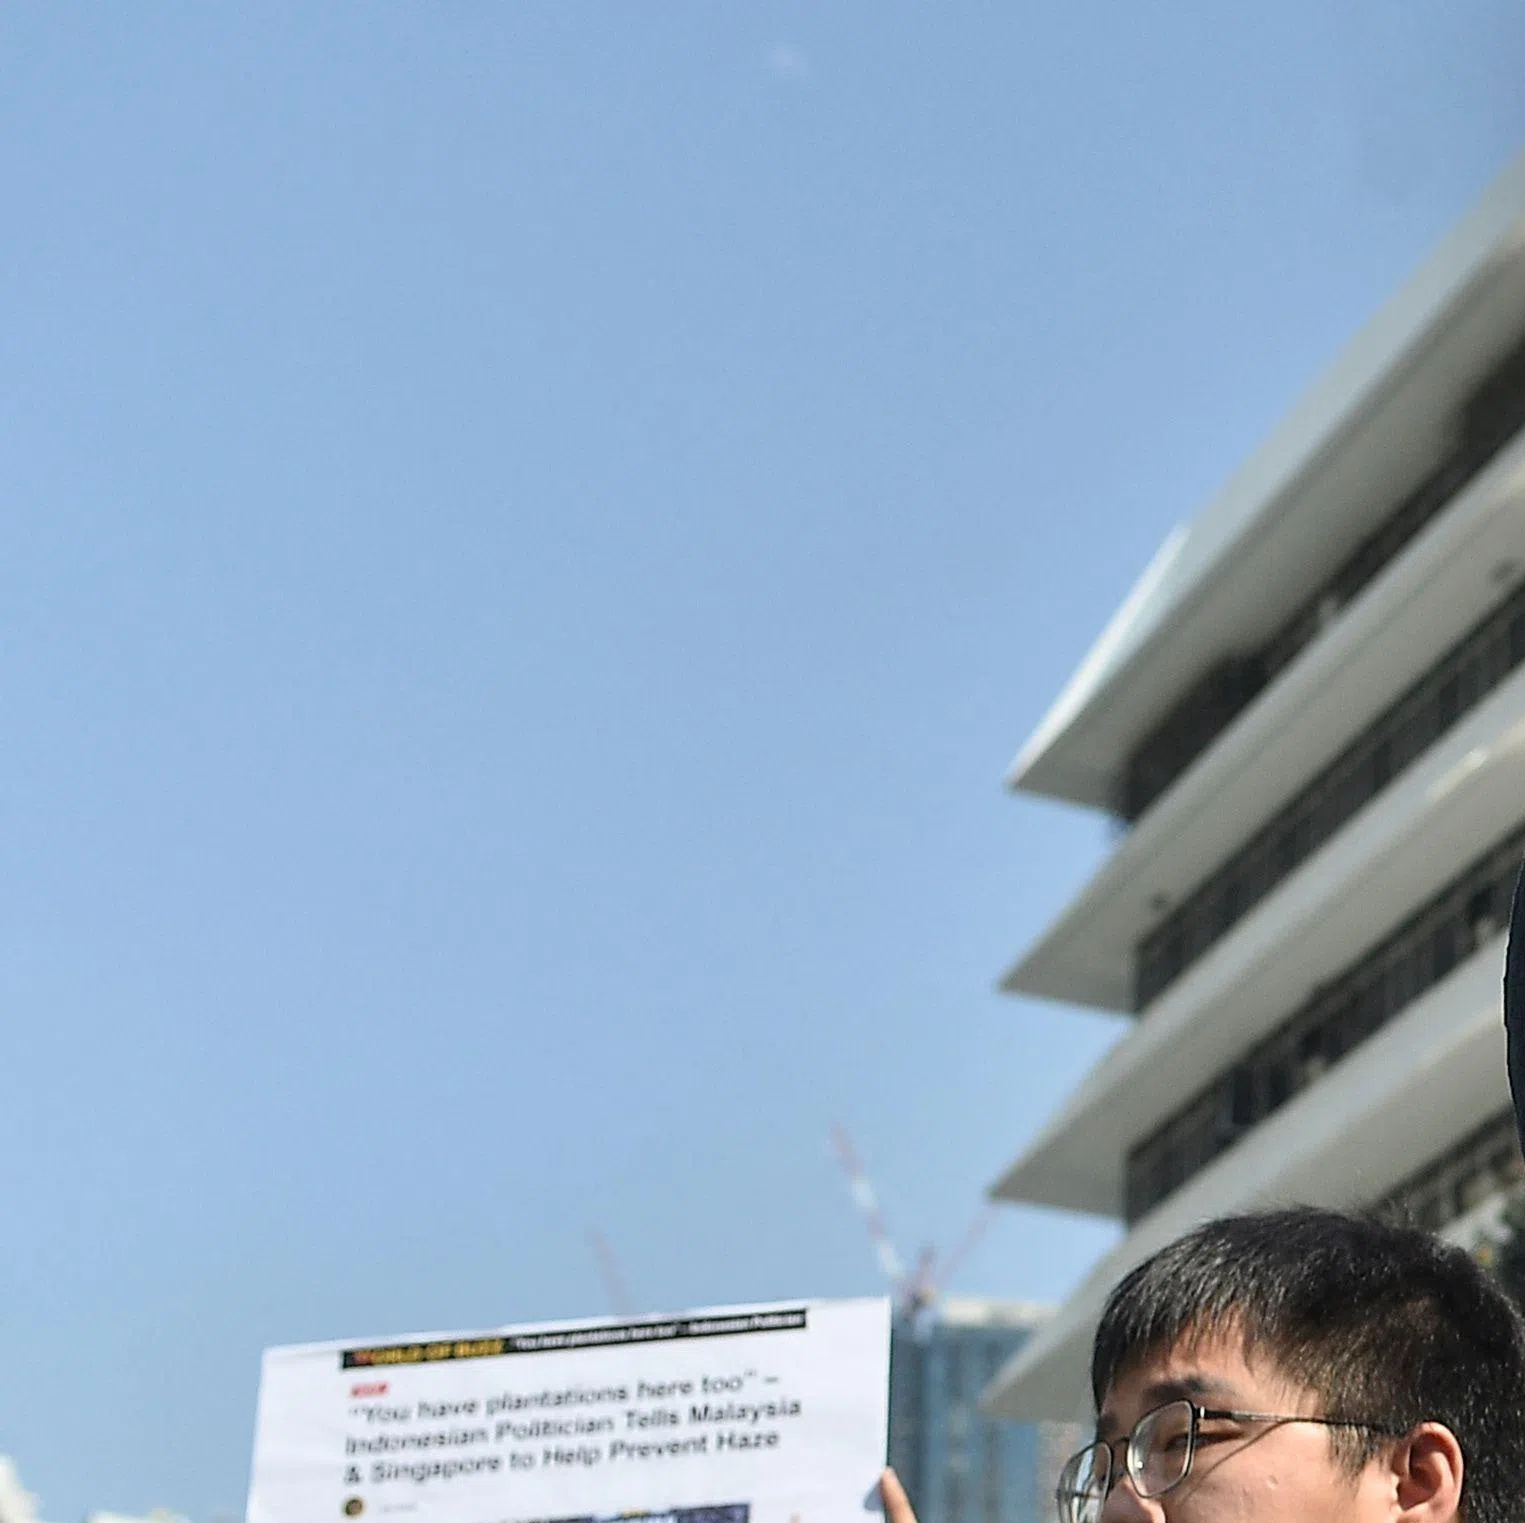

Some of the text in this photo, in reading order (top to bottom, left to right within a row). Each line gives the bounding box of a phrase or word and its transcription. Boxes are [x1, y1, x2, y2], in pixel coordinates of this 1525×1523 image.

[417, 1400, 477, 1419] have
[486, 1383, 629, 1416] plantations
[637, 1377, 694, 1398] here
[345, 1399, 802, 1455] Indonesian Politician Tells Malaysia
[344, 1430, 779, 1484] & Singapore to Help Prevent Haze
